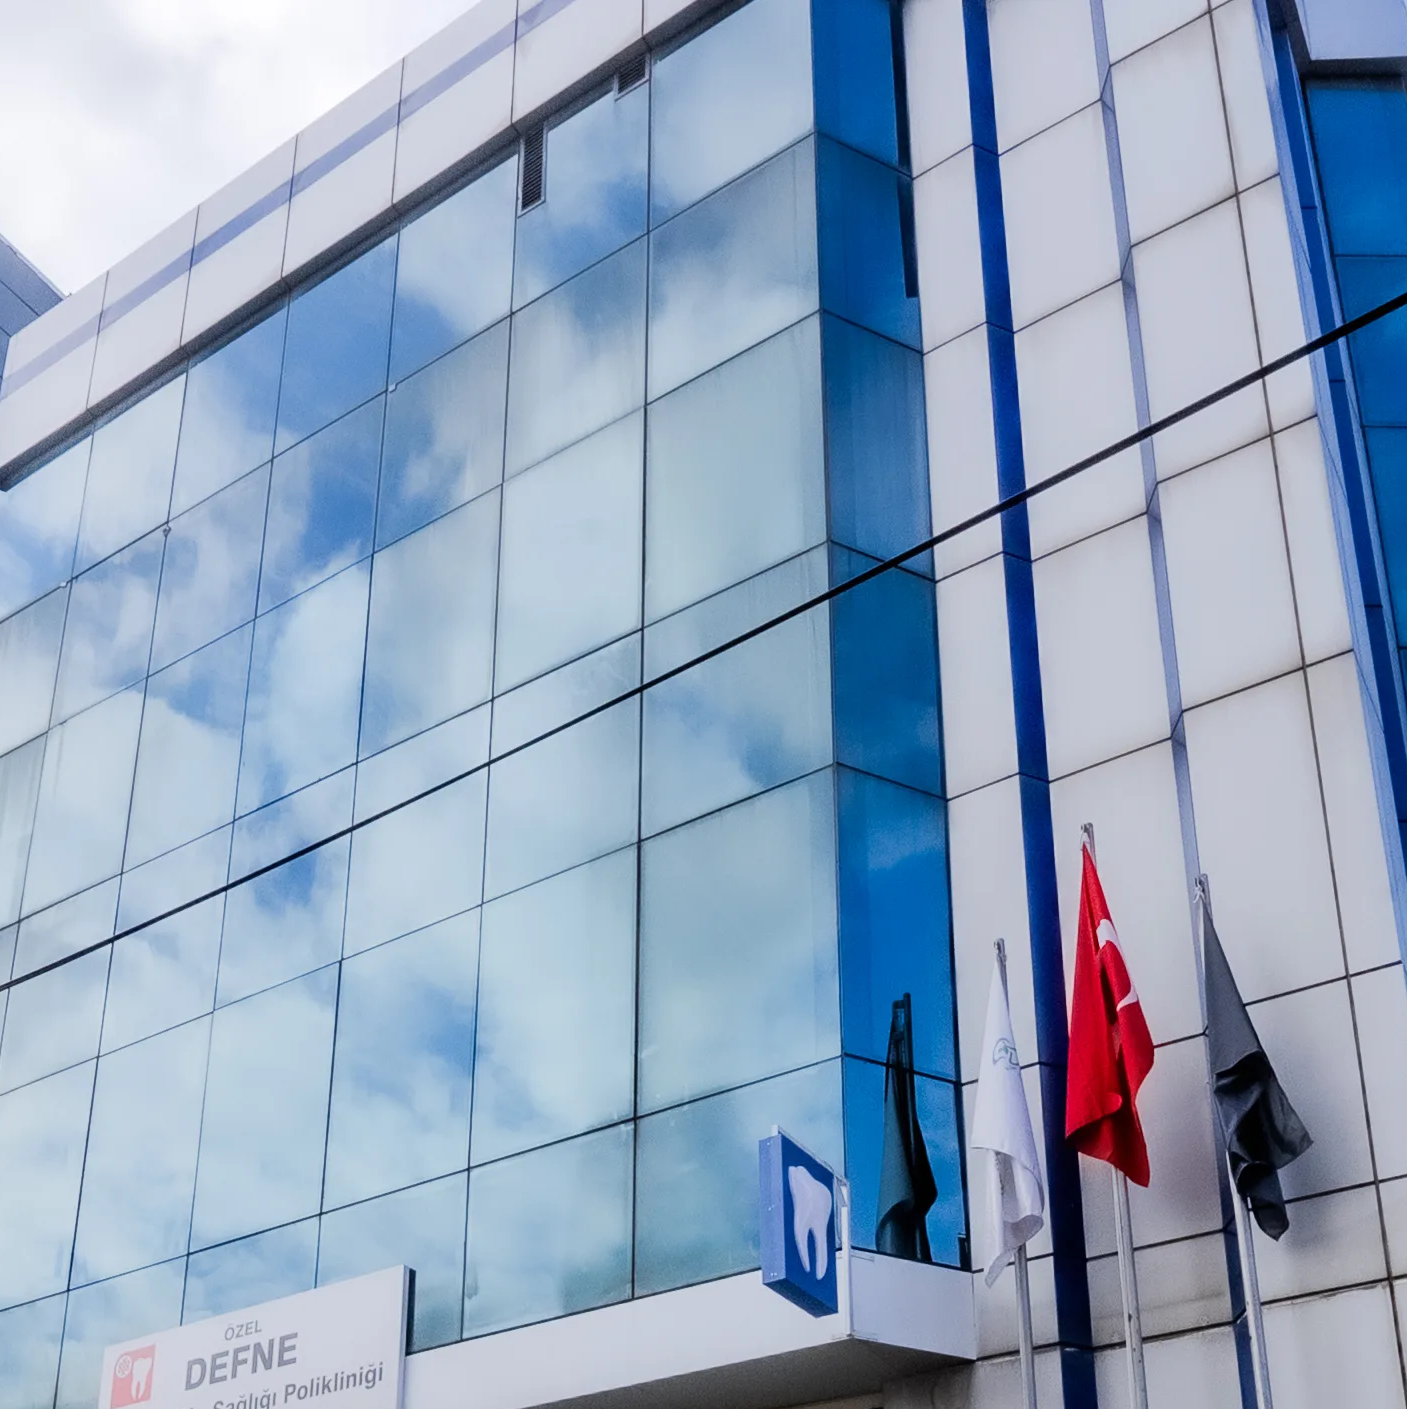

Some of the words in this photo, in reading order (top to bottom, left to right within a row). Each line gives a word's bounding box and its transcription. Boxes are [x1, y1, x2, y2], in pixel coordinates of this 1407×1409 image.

[224, 1320, 262, 1341] ÖZEL
[184, 1332, 298, 1391] DEFNE
[284, 1361, 384, 1404] Polikliniği
